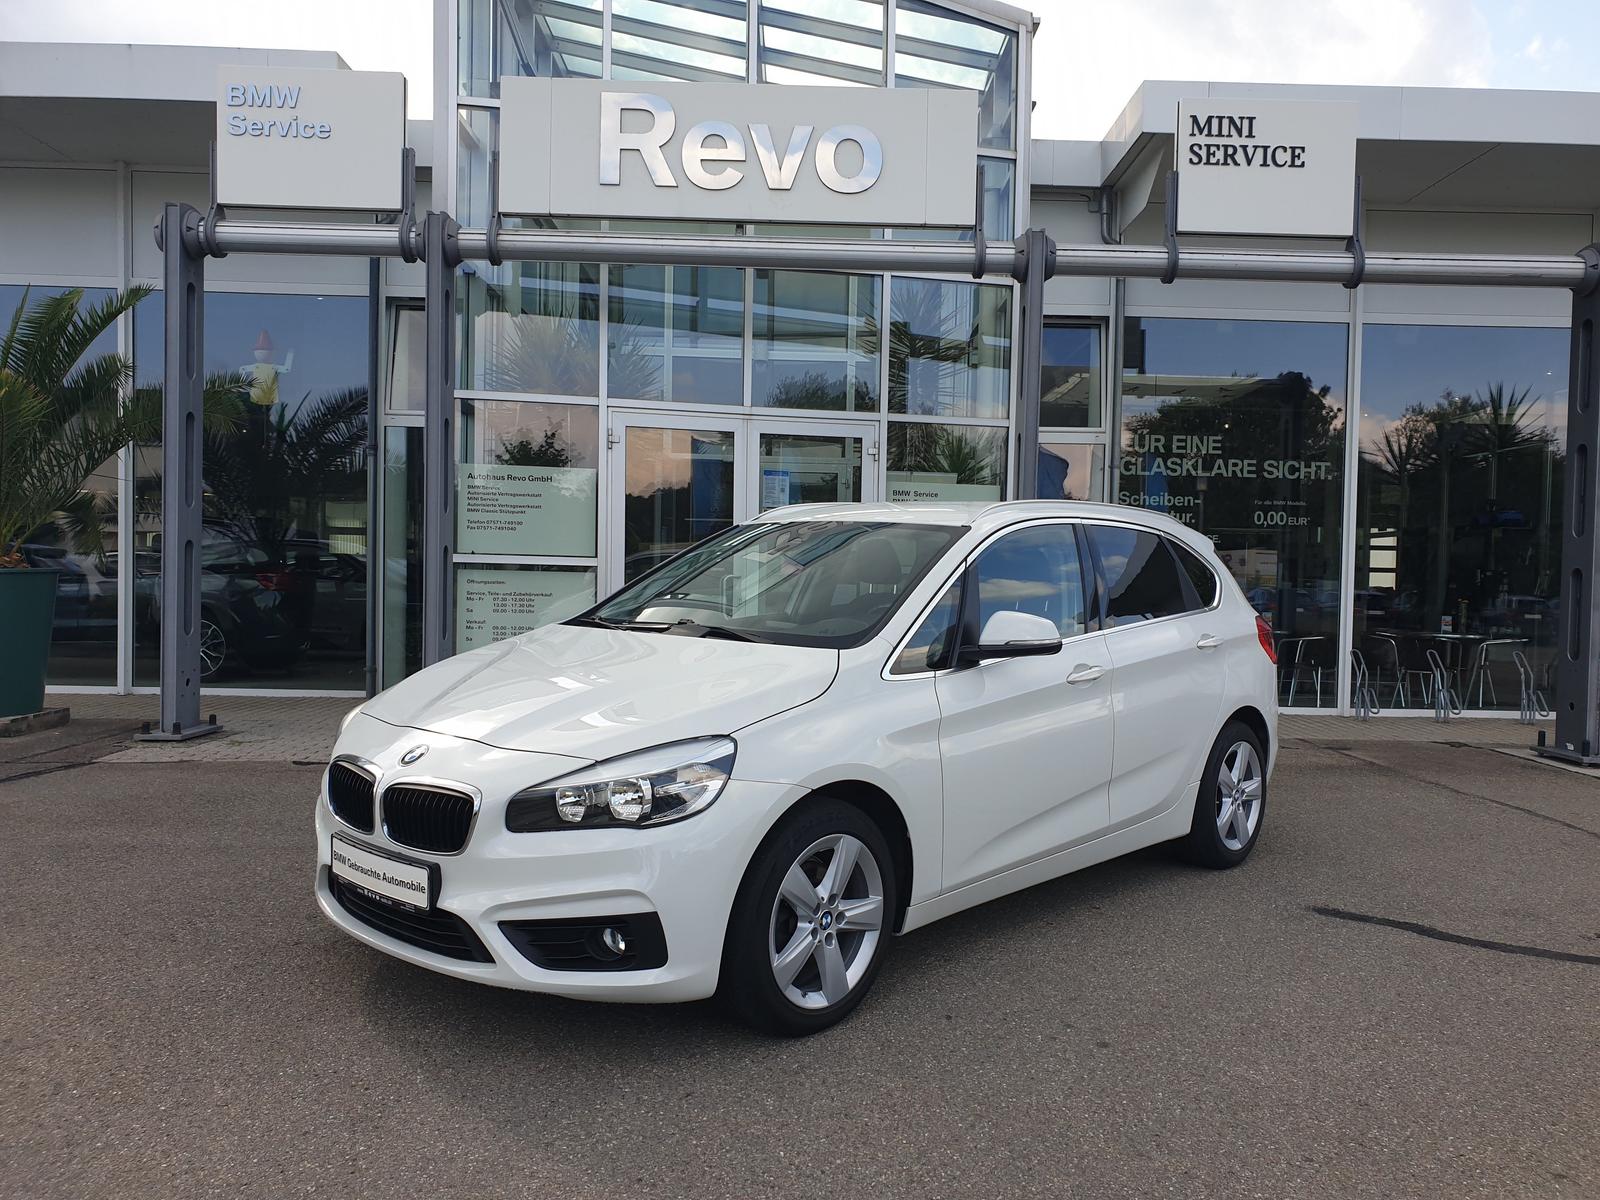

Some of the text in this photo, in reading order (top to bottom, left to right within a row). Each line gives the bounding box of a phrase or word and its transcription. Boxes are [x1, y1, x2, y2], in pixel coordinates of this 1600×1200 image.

[227, 83, 301, 109] BMW
[227, 112, 332, 139] Service
[1189, 114, 1256, 138] MINI
[599, 91, 883, 195] Revo
[1188, 143, 1305, 168] SERVICE
[1131, 429, 1222, 455] ÜR EINE
[467, 472, 506, 481] Autohaus
[506, 474, 527, 482] Revo
[1120, 457, 1333, 480] GLASKLARE SICHT.
[892, 489, 939, 498] BMW Service
[1118, 490, 1201, 507] Scheiben-
[1254, 511, 1287, 527] 0,00
[333, 850, 426, 894] BMW Gebrauchte Automobile
